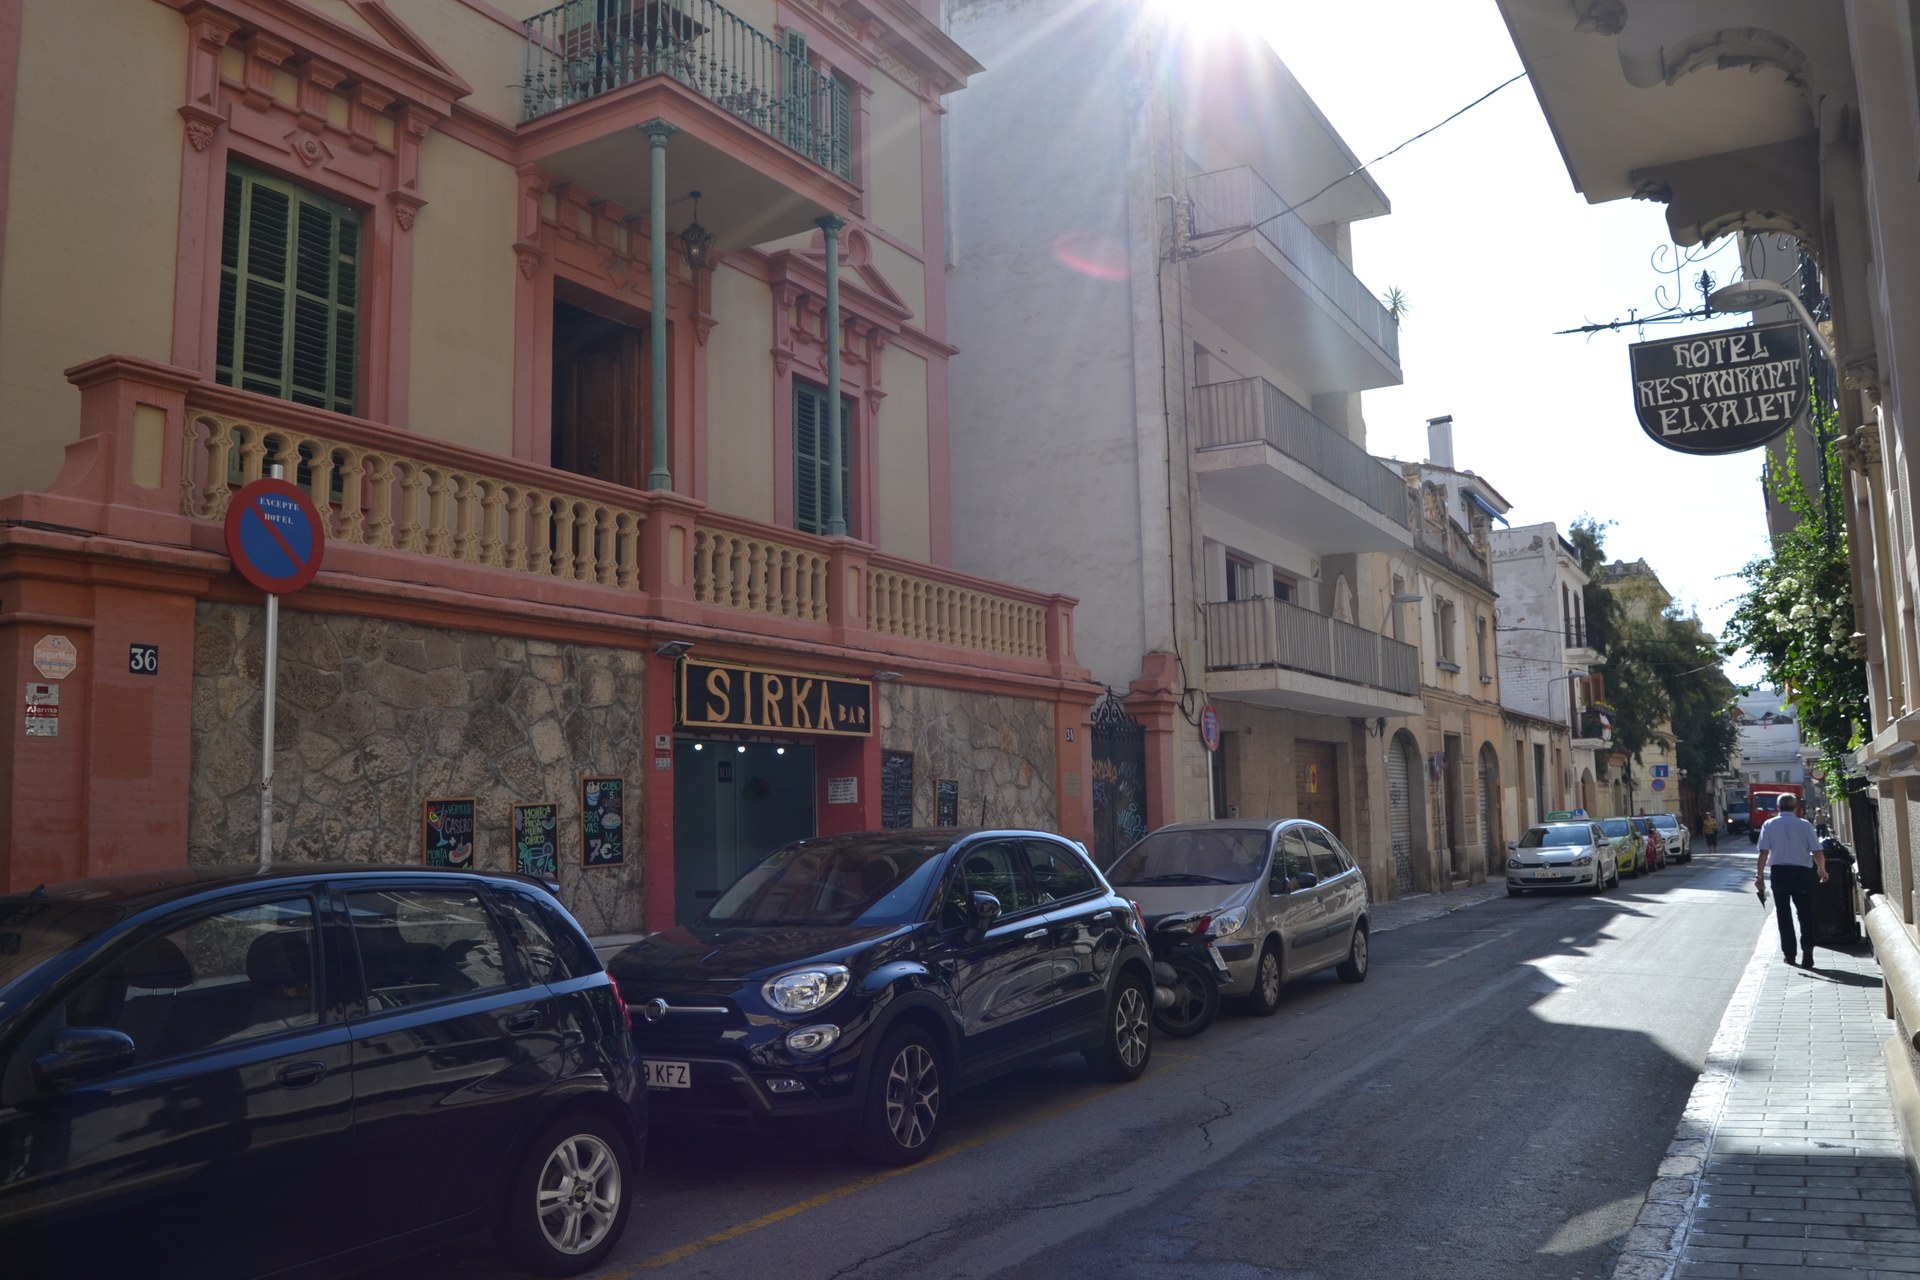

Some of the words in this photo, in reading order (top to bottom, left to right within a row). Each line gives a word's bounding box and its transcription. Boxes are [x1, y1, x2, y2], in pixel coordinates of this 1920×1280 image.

[1673, 332, 1769, 369] HOTEL
[1637, 358, 1800, 408] RESTAURANT
[260, 497, 300, 511] EXCEPTE
[264, 513, 294, 525] HOTEL
[131, 647, 157, 671] 36
[706, 668, 835, 730] SIRKA
[838, 704, 866, 724] BAR
[445, 818, 472, 834] CASERO
[656, 1064, 687, 1085] KFZ
